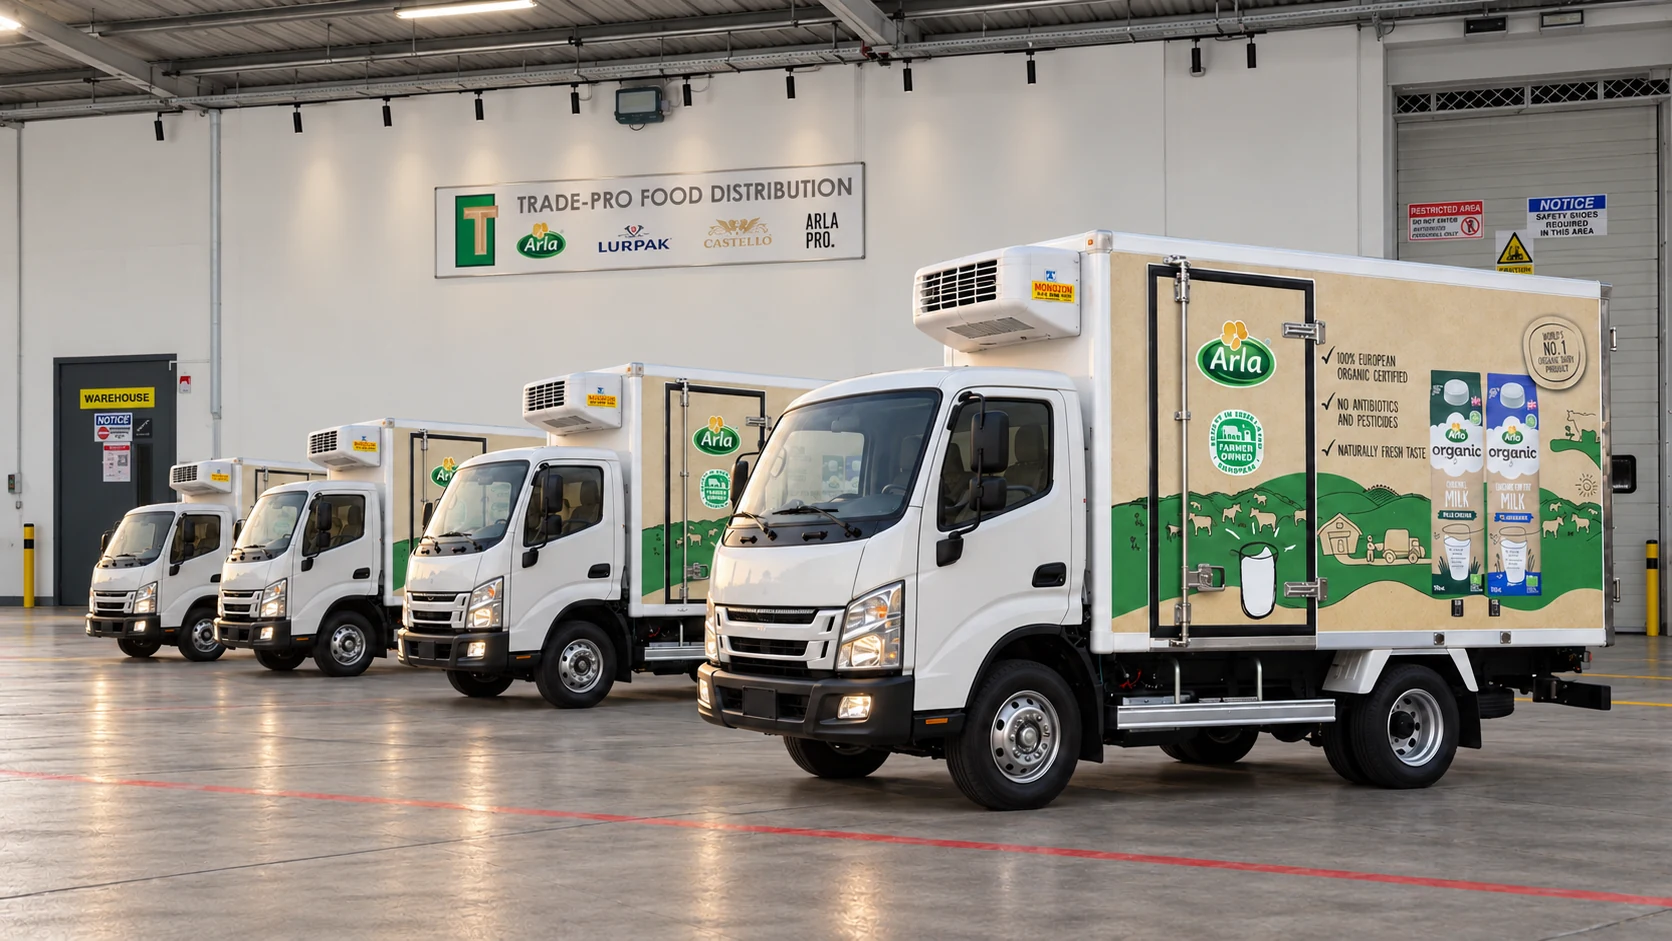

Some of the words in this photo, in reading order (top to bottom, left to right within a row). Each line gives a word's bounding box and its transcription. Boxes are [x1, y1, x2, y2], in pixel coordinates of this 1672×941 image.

[517, 190, 633, 214] TRADE-PRO
[641, 186, 703, 207] FOOD
[711, 177, 852, 203] DISTRIBUTION
[1540, 197, 1595, 211] NOTICE
[805, 212, 839, 230] ARLA
[1536, 212, 1567, 221] SAFETY
[1546, 220, 1589, 228] REQUIRED
[1572, 227, 1594, 235] AREA
[524, 236, 558, 252] Arla
[598, 238, 670, 253] LURPAK
[703, 236, 772, 249] CASTELLO
[806, 231, 835, 249] PRO.
[1210, 346, 1262, 374] Arla
[1337, 352, 1355, 365] 100%
[1359, 353, 1396, 367] EUROPEAN
[1337, 367, 1370, 381] ORGANIC
[1373, 370, 1408, 383] CERTIFIED
[84, 393, 150, 403] WAREHOUSE
[1337, 398, 1349, 411] NO
[1353, 399, 1399, 413] ANTIBIOTICS
[97, 415, 130, 424] NOTICE
[1338, 413, 1354, 427] AND
[1357, 415, 1399, 428] PESTICIDES
[701, 431, 733, 448] Arla
[1219, 443, 1253, 452] FARMER
[1338, 444, 1379, 458] NATURALLY
[1381, 445, 1404, 459] FRESH
[1406, 446, 1426, 459] TASTE
[1432, 444, 1481, 459] organic
[1489, 446, 1537, 461] organic
[1221, 453, 1253, 461] OWNED
[1445, 490, 1469, 508] MILK
[1500, 493, 1525, 510] MILK
